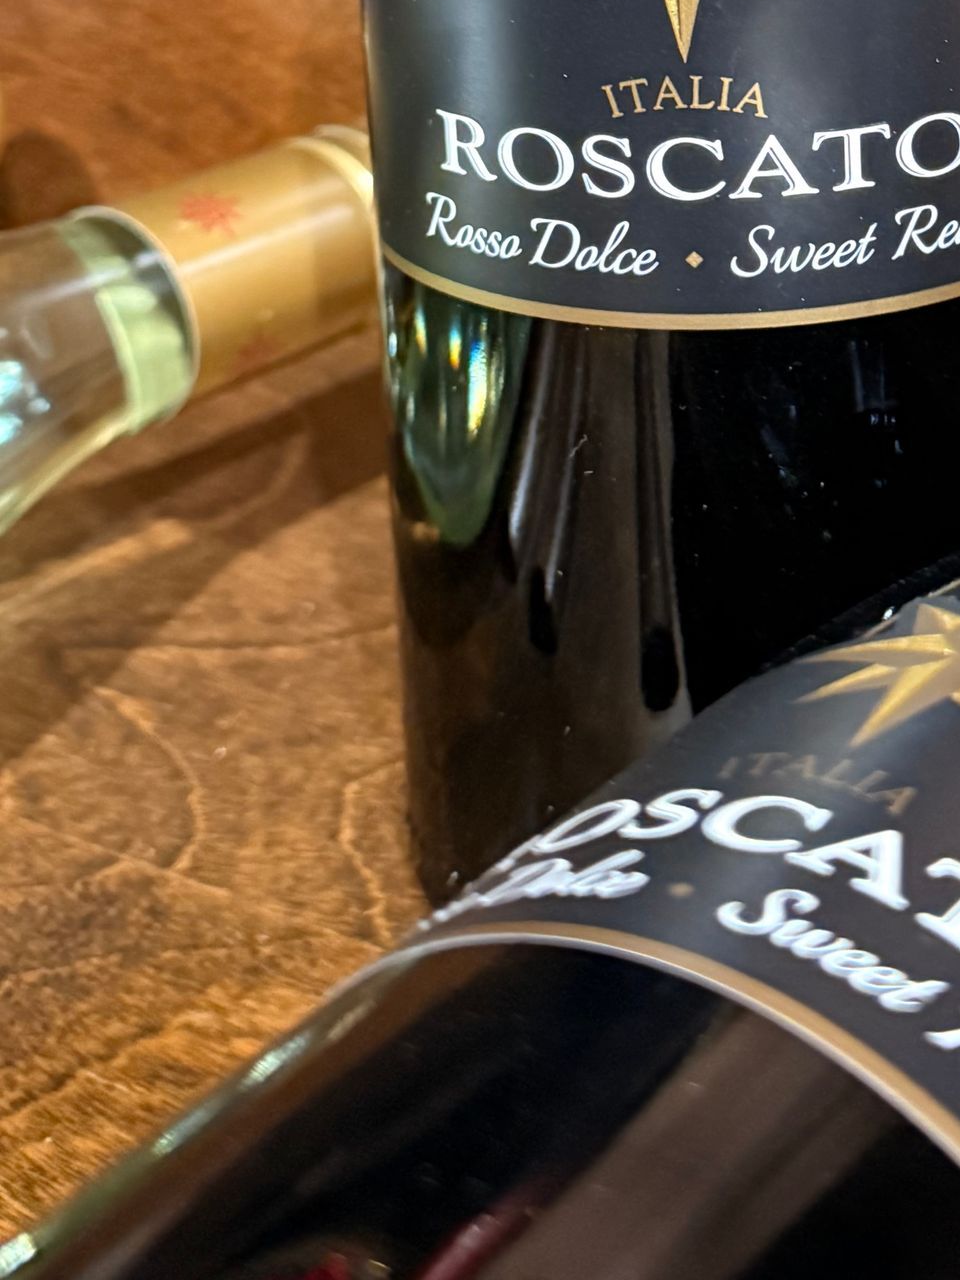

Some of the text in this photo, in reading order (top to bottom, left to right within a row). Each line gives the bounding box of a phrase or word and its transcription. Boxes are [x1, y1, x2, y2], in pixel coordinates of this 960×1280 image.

[601, 74, 769, 119] ITALIA
[425, 191, 523, 260] Rosso
[528, 217, 660, 276] Dolce
[730, 224, 878, 278] Sweet
[716, 750, 919, 816] ITALIA
[715, 888, 950, 1013] Sweet
